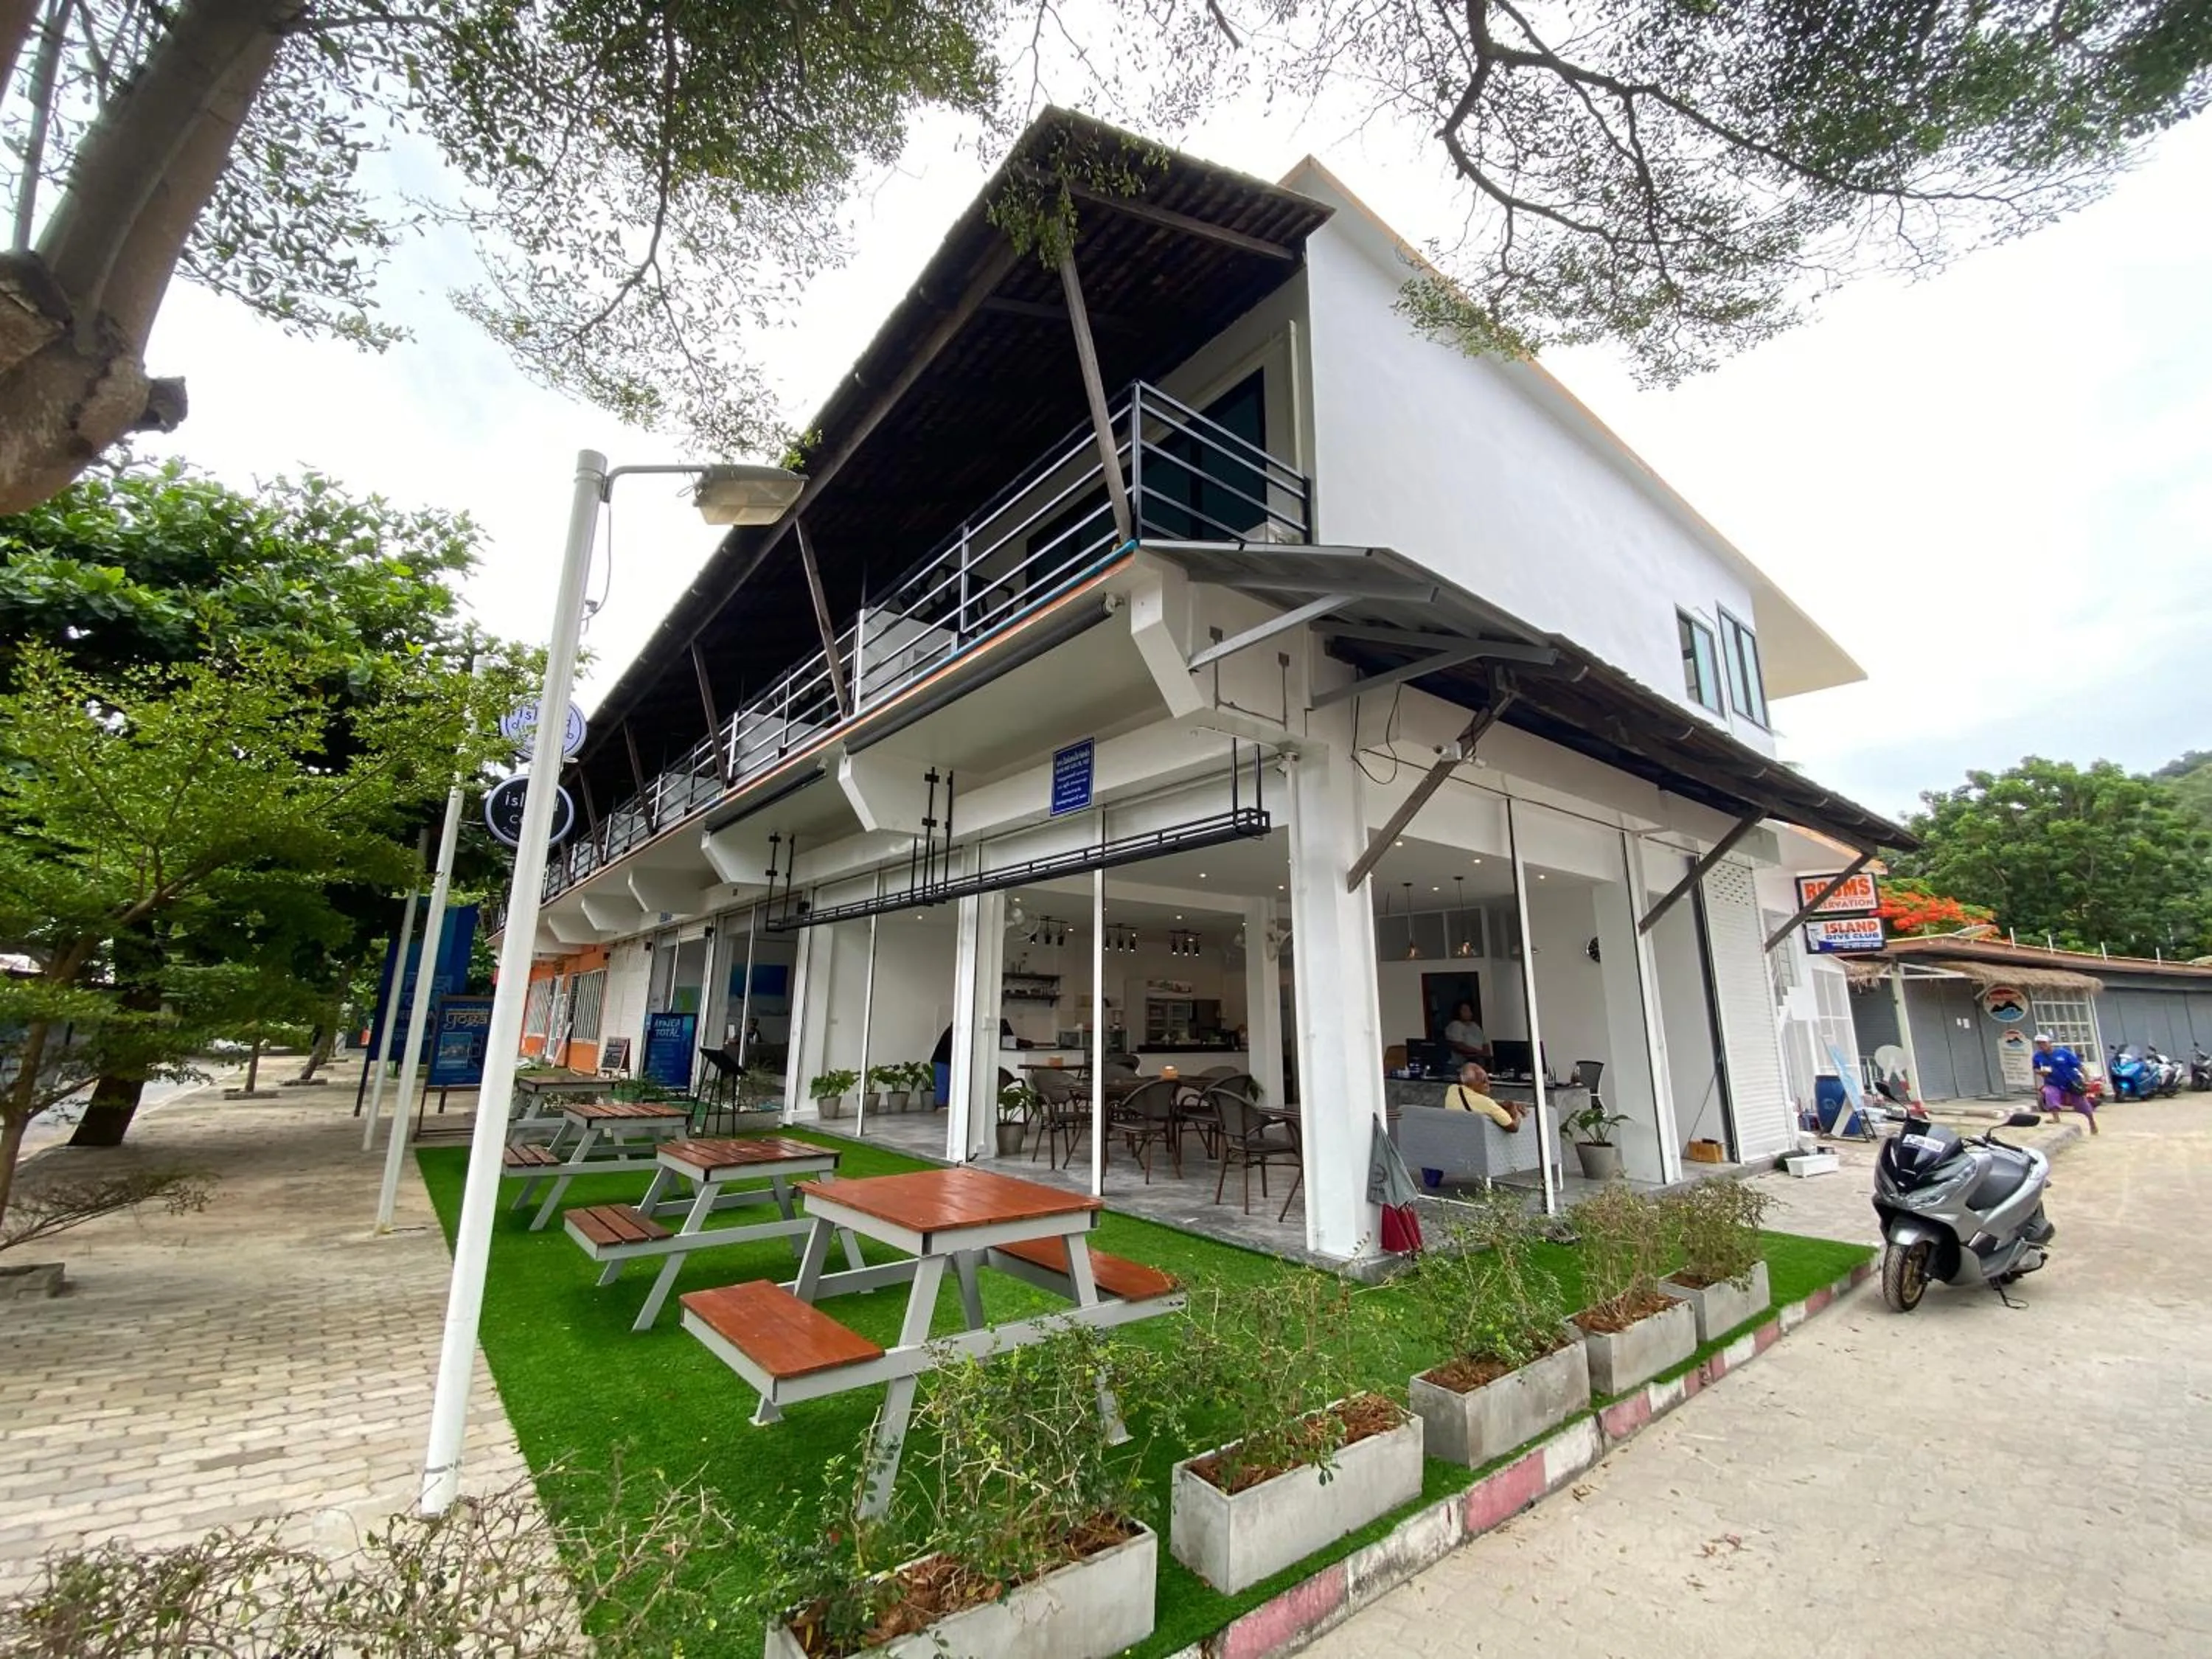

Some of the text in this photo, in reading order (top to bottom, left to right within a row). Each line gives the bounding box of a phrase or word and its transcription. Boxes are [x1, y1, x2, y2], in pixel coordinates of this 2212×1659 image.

[505, 791, 560, 812] isl
[1818, 899, 1874, 909] ERVATION
[1825, 920, 1877, 933] ISLAND
[655, 1029, 681, 1037] TOTAL
